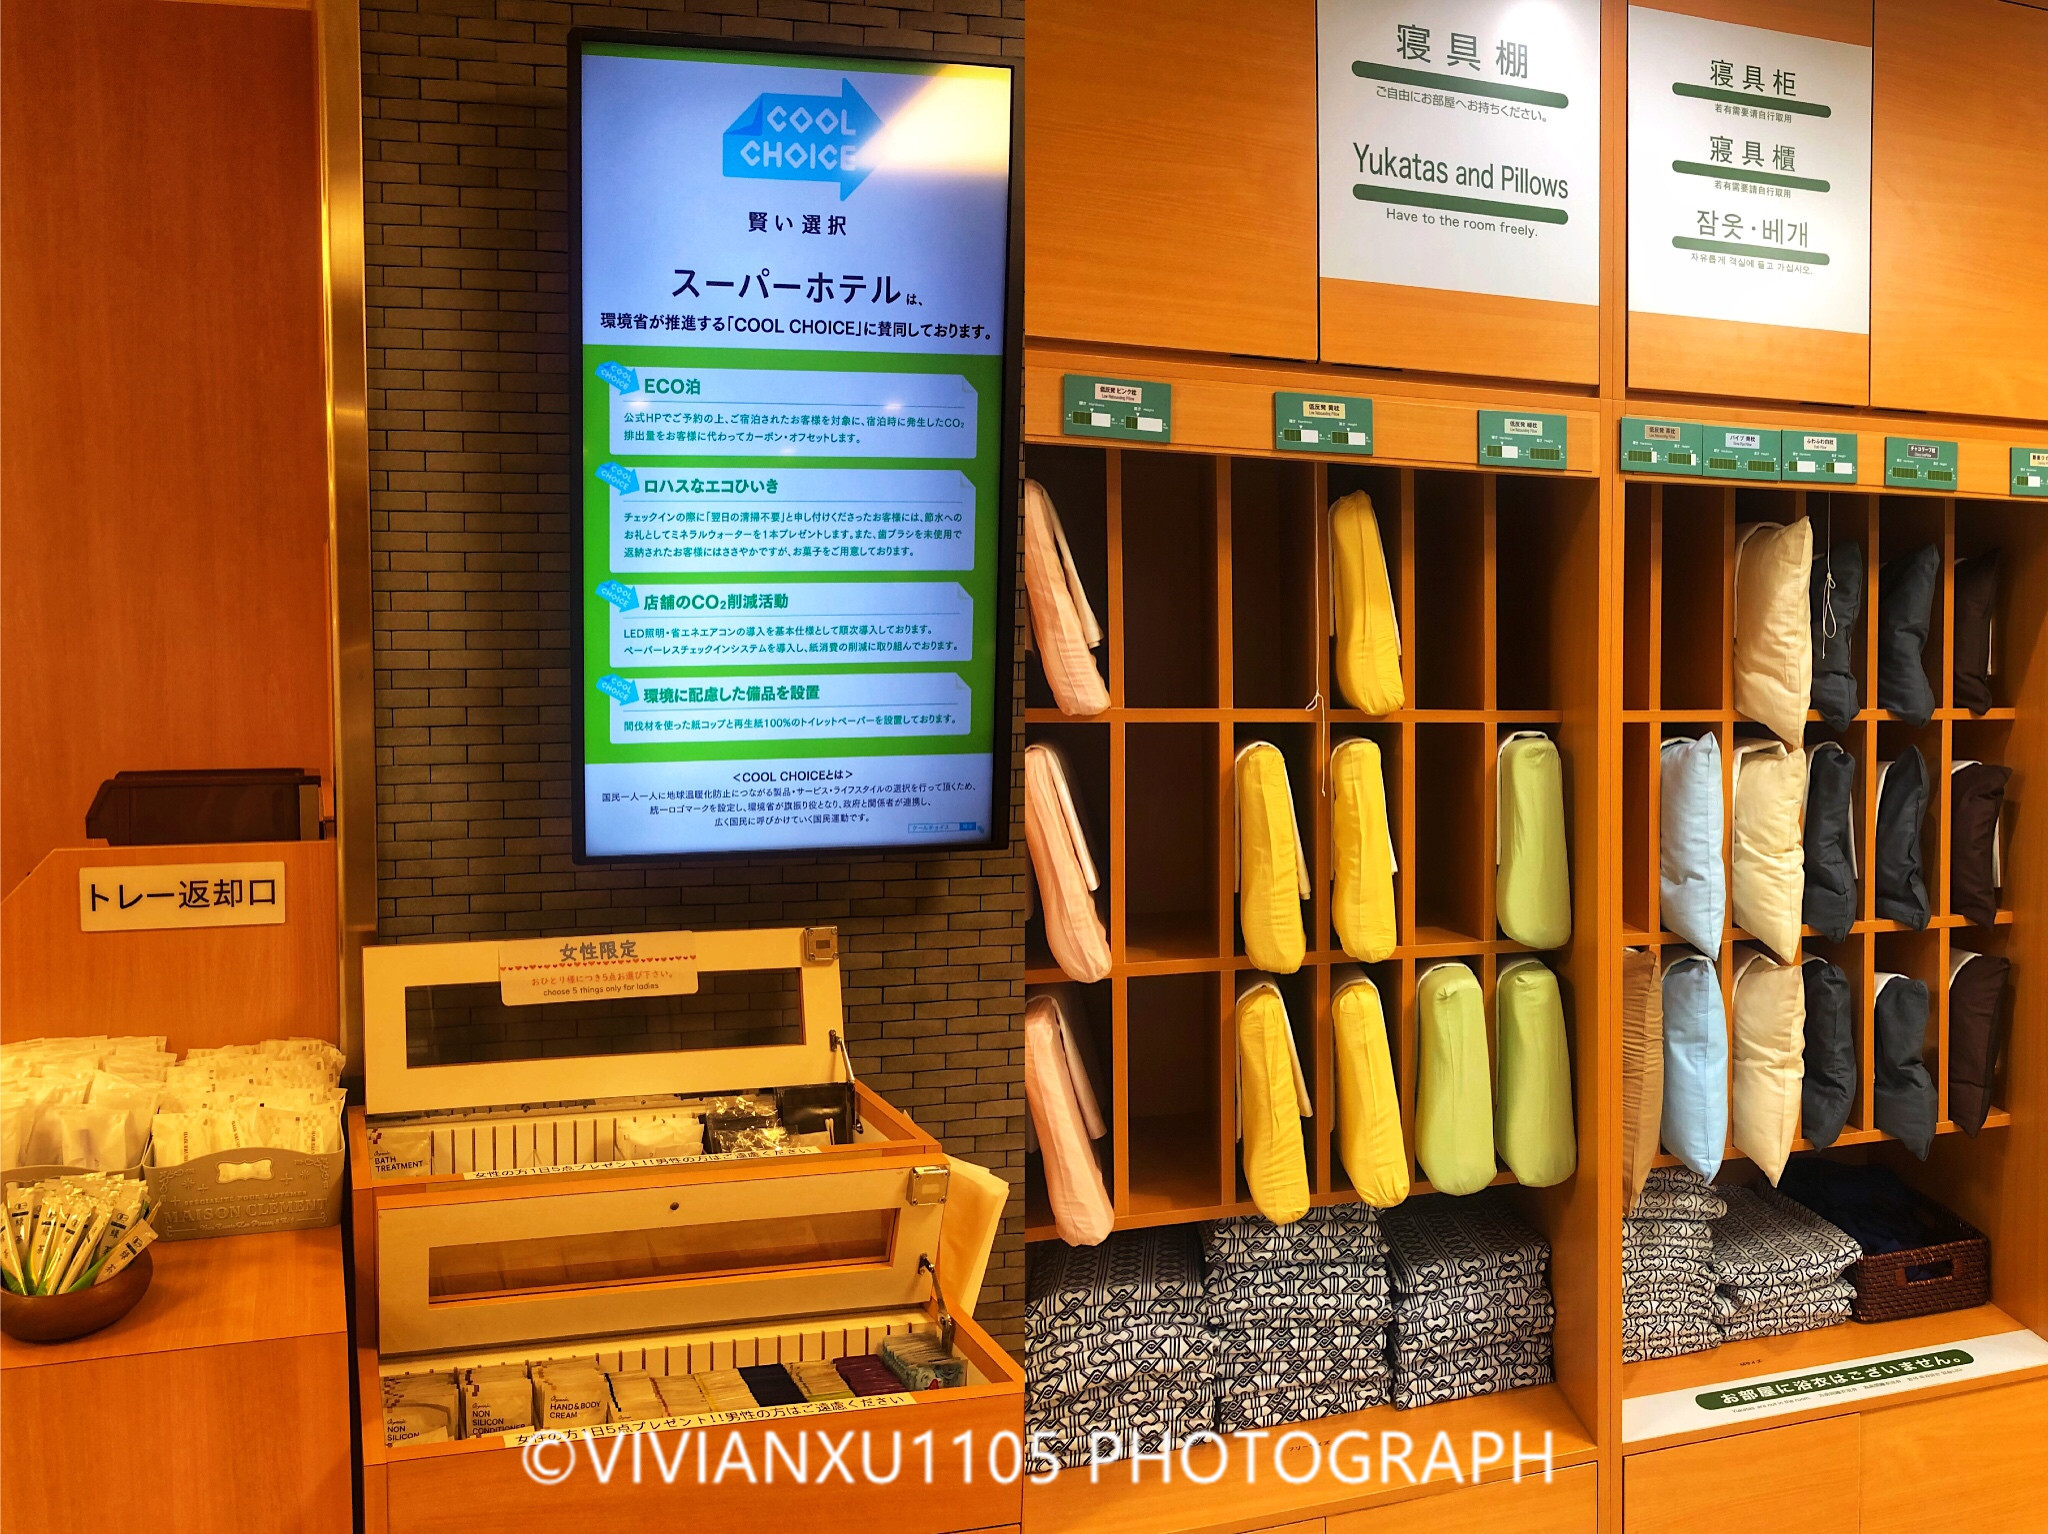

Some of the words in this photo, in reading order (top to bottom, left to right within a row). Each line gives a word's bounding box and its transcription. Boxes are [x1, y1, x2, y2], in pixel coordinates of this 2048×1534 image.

[1396, 23, 1529, 79] 寝具棚
[1709, 59, 1797, 97] 寝具柜
[1376, 85, 1548, 123] ご自由にお部屋へお持ちください。
[1714, 103, 1793, 124] 若有需要请自行取用
[766, 104, 858, 136] COOL
[739, 139, 858, 171] CHOICE
[1352, 142, 1449, 184] Yukatas
[1455, 163, 1494, 190] and
[1501, 165, 1569, 199] Pillows
[1713, 180, 1792, 199] 若有需要請自行取用
[748, 211, 848, 237] 賢い選択
[1386, 207, 1418, 223] Have
[1422, 213, 1436, 225] to
[1440, 215, 1460, 228] the
[1464, 219, 1497, 232] room
[1499, 221, 1539, 238] freely.
[1696, 209, 1809, 249] 잠옷·베개
[600, 311, 785, 335] 環境省が推進する「COOL
[789, 318, 992, 341] CHOICE」に賛同しております。
[600, 368, 630, 390] CHOICE
[610, 364, 632, 383] COOL
[644, 377, 701, 396] ECO泊
[600, 469, 630, 491] CHOICE
[610, 464, 632, 484] COOL
[644, 477, 779, 495] ロハスなエコひいき
[600, 587, 630, 608] CHOICE
[610, 583, 632, 600] COOL
[643, 685, 821, 704] 環境に配慮した備品を設置
[91, 878, 276, 912] トレー返却口
[559, 939, 639, 962] 女性限定
[531, 970, 674, 986] おひとり様につき5点お選び下さい。
[543, 987, 570, 996] choose
[572, 986, 578, 994] 5
[579, 984, 604, 995] things
[605, 984, 622, 994] only
[623, 983, 635, 991] for
[636, 981, 660, 990] ladies
[374, 1156, 397, 1165] BATH
[375, 1160, 424, 1173] TREATMENT
[163, 1205, 241, 1224] MAISON
[1719, 1353, 1962, 1405] お部屋に浴衣はございません。
[472, 1410, 491, 1418] NON
[472, 1418, 504, 1426] SILICON
[549, 1411, 578, 1419] CREAM
[387, 1425, 406, 1433] NON
[387, 1431, 420, 1442] SILICON
